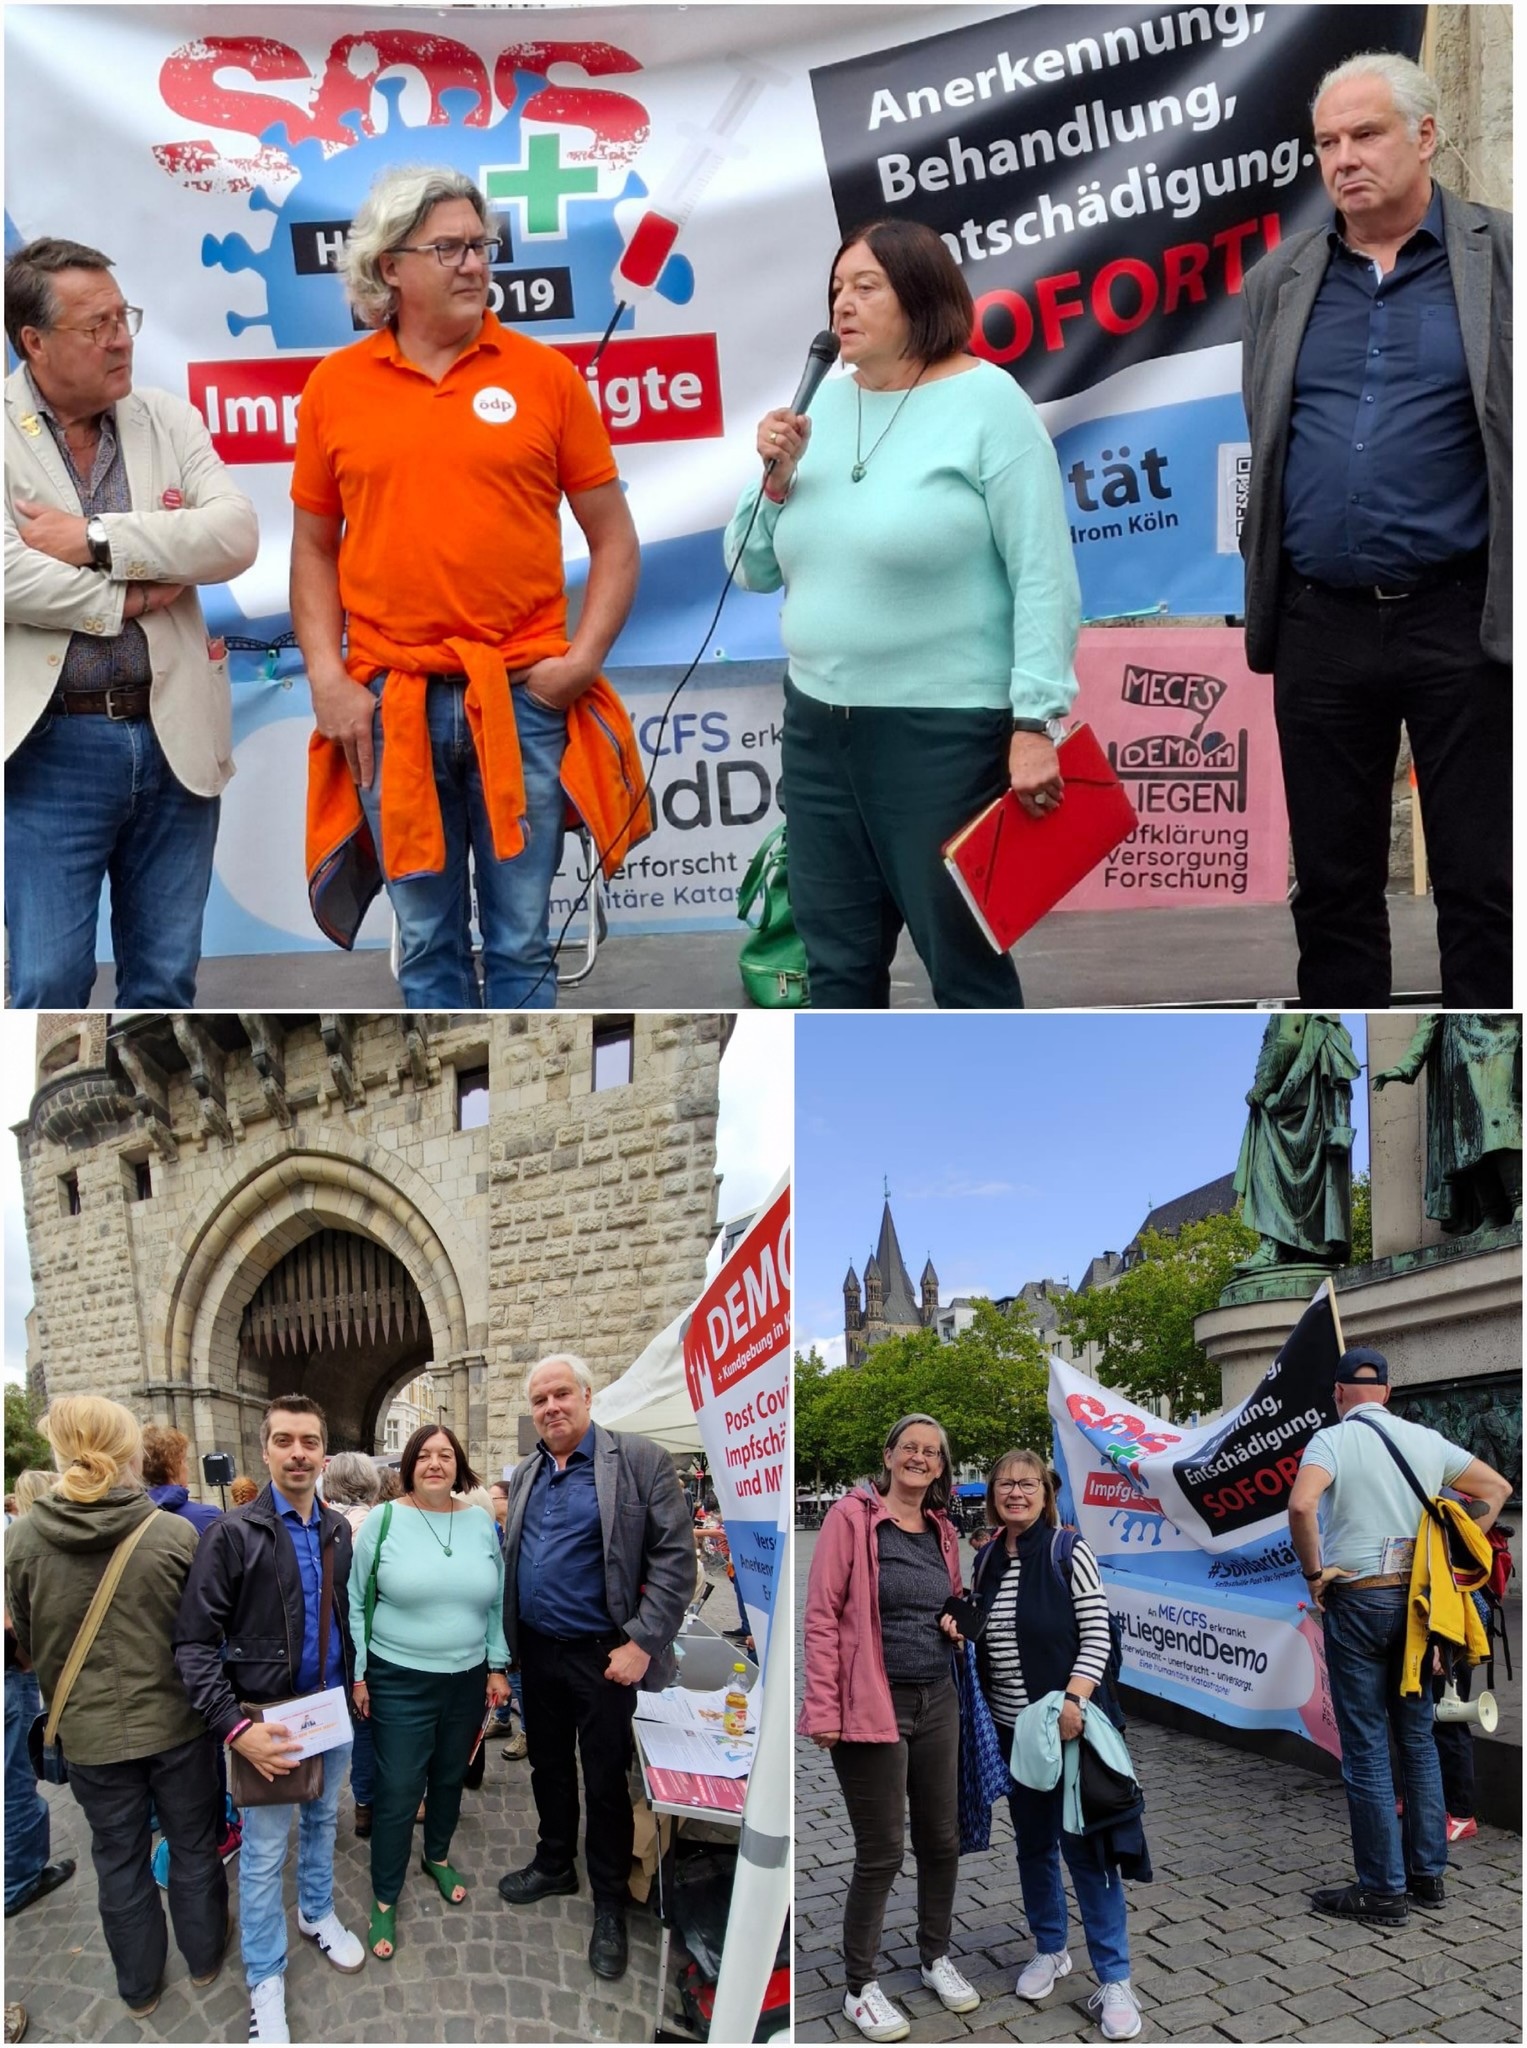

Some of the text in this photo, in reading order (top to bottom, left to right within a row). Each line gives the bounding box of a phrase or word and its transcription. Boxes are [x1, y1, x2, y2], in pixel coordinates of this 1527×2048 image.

[868, 4, 1266, 131] Anerkennung,
[152, 28, 651, 193] SOS
[877, 82, 1237, 204] Behandlung,
[938, 137, 1315, 265] ntschädigung.
[968, 212, 1282, 364] OFORT!
[1128, 510, 1179, 535] Köln
[1124, 669, 1220, 710] MECFS
[631, 711, 731, 756] CFS
[1120, 782, 1236, 813] IEGEN
[1123, 824, 1248, 850] ufklärung
[577, 850, 738, 883] uerforscht
[1104, 868, 1248, 894] Forschung
[722, 1332, 773, 1381] Kundgebung
[773, 1321, 784, 1341] in
[725, 1375, 789, 1434] Post Covi
[1184, 1407, 1327, 1486] Entschädigung.
[735, 1469, 762, 1498] und
[1202, 1448, 1304, 1519] SOFOR
[753, 1531, 777, 1551] Vers
[1208, 1540, 1297, 1579] #Solidaritä
[1116, 1610, 1268, 1674] #LiegendDemo
[1158, 1603, 1207, 1630] ME/CFS
[1209, 1623, 1247, 1639] erkrankt
